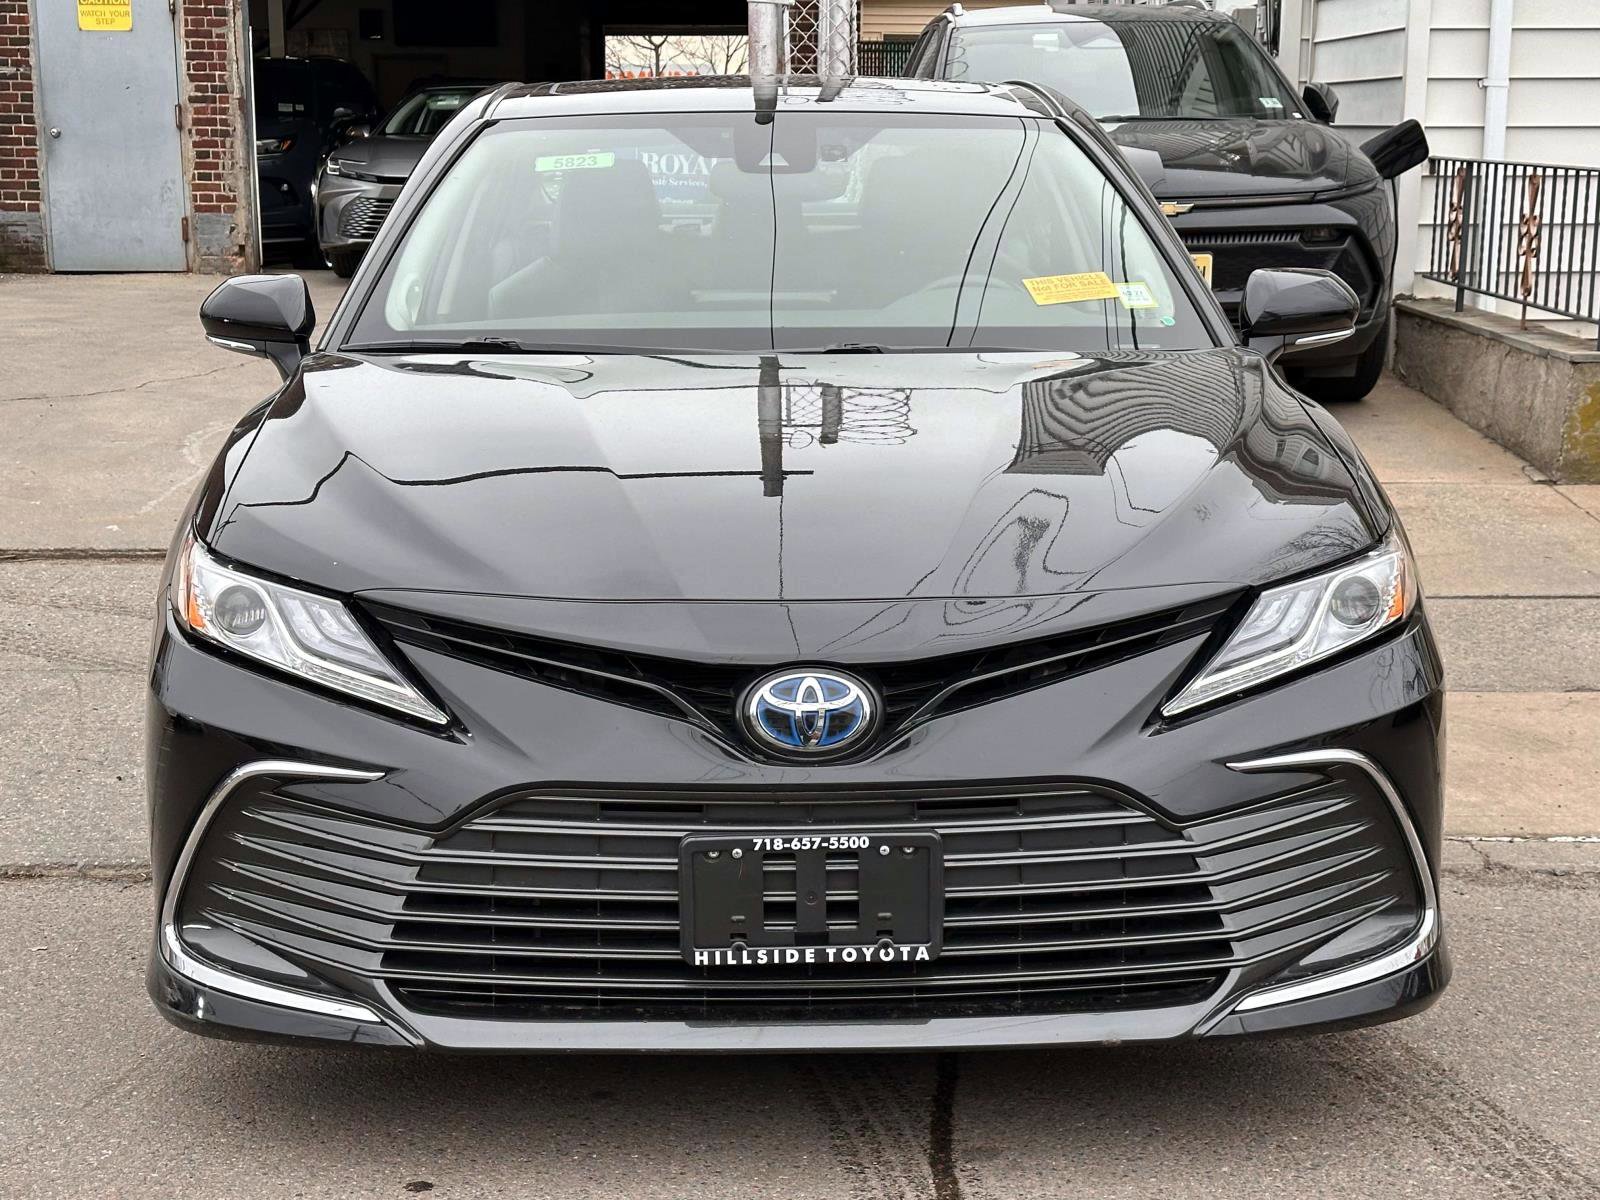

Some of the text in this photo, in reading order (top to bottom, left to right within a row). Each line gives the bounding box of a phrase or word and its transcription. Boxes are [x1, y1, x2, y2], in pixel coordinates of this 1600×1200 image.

[95, 17, 116, 25] STEP
[553, 155, 598, 169] 5823
[1054, 281, 1078, 290] FOR
[1079, 278, 1107, 288] SALE
[1056, 273, 1104, 284] VEHICLE
[752, 836, 870, 851] 718-657-5500
[694, 946, 930, 966] HILLSIDE TOYOTA
